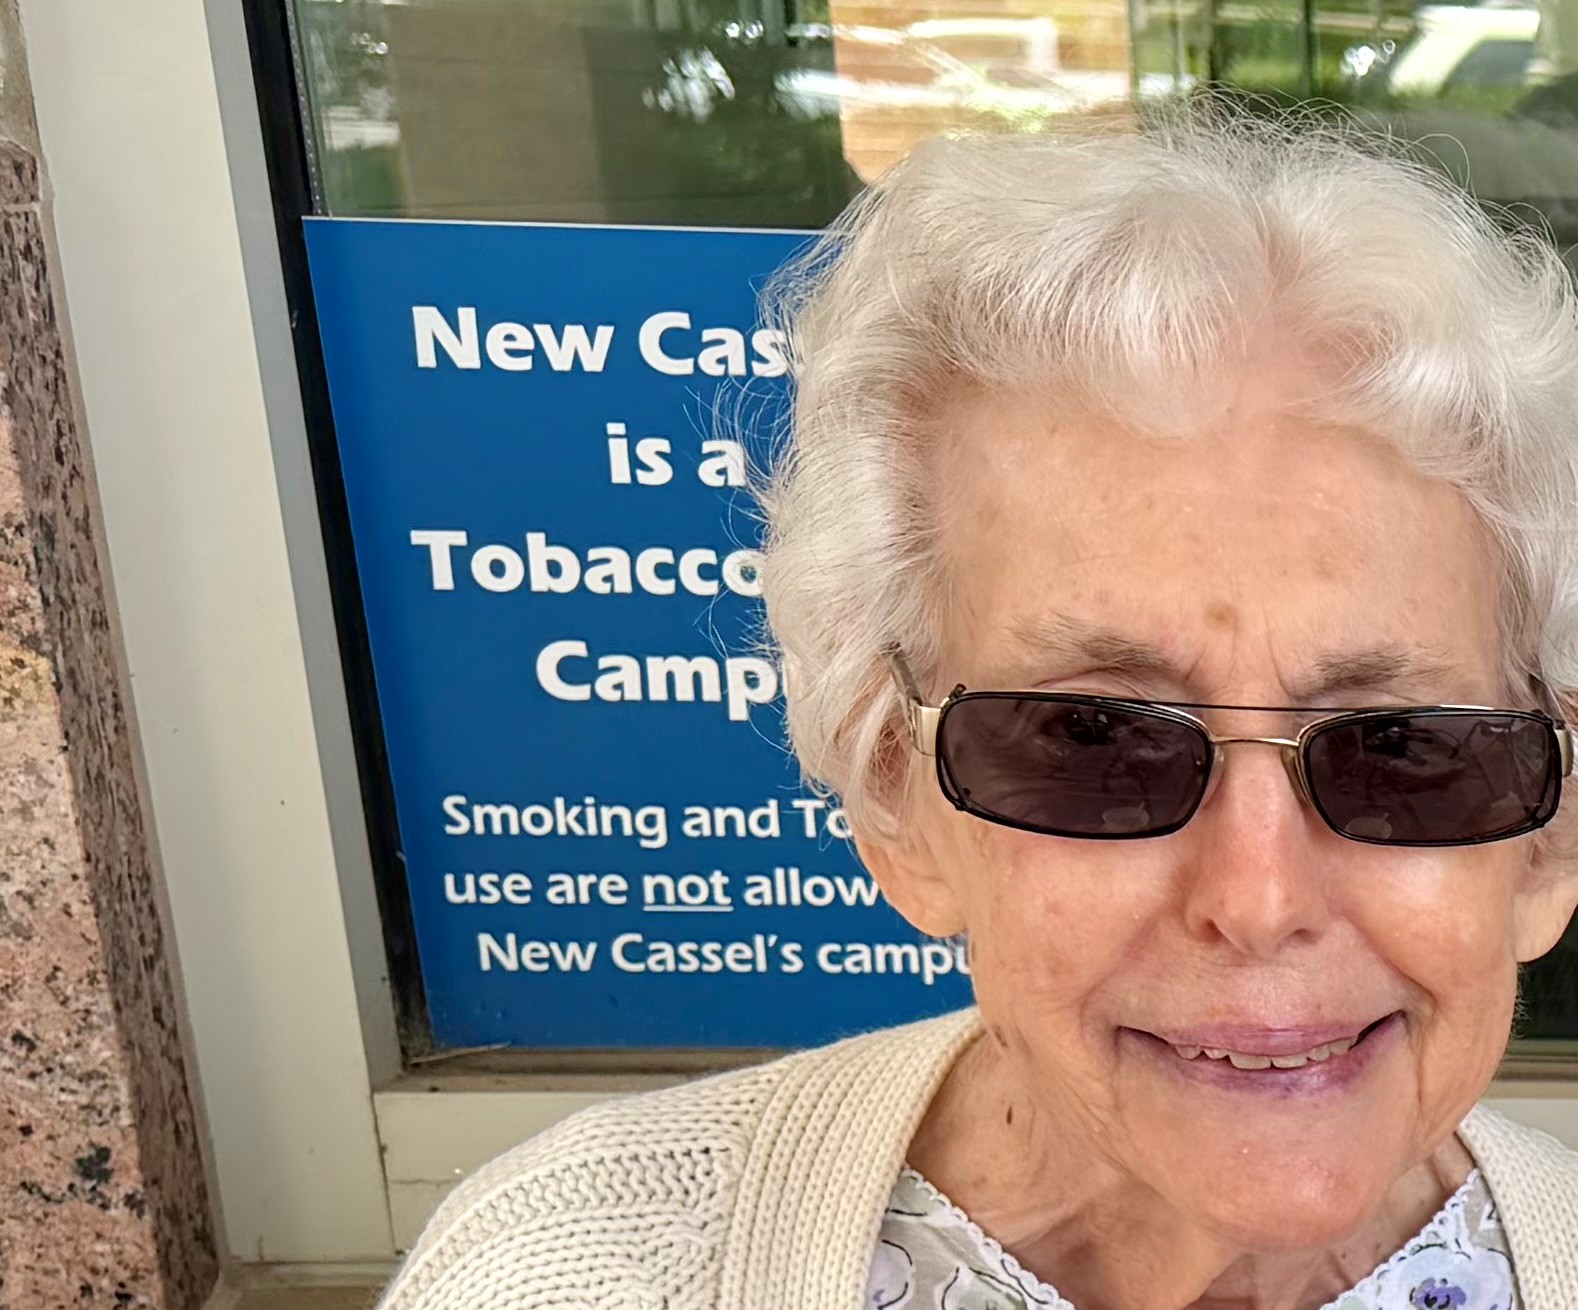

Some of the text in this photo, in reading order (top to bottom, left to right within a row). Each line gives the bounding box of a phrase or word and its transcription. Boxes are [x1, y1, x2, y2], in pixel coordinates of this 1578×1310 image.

[413, 306, 788, 378] New Cas
[606, 420, 747, 488] is a
[410, 529, 764, 596] Tobacco
[536, 640, 783, 721] Camp
[442, 795, 853, 849] Smoking and To
[444, 867, 879, 912] use are not allow
[477, 933, 597, 972] New
[611, 932, 803, 974] Cassel's
